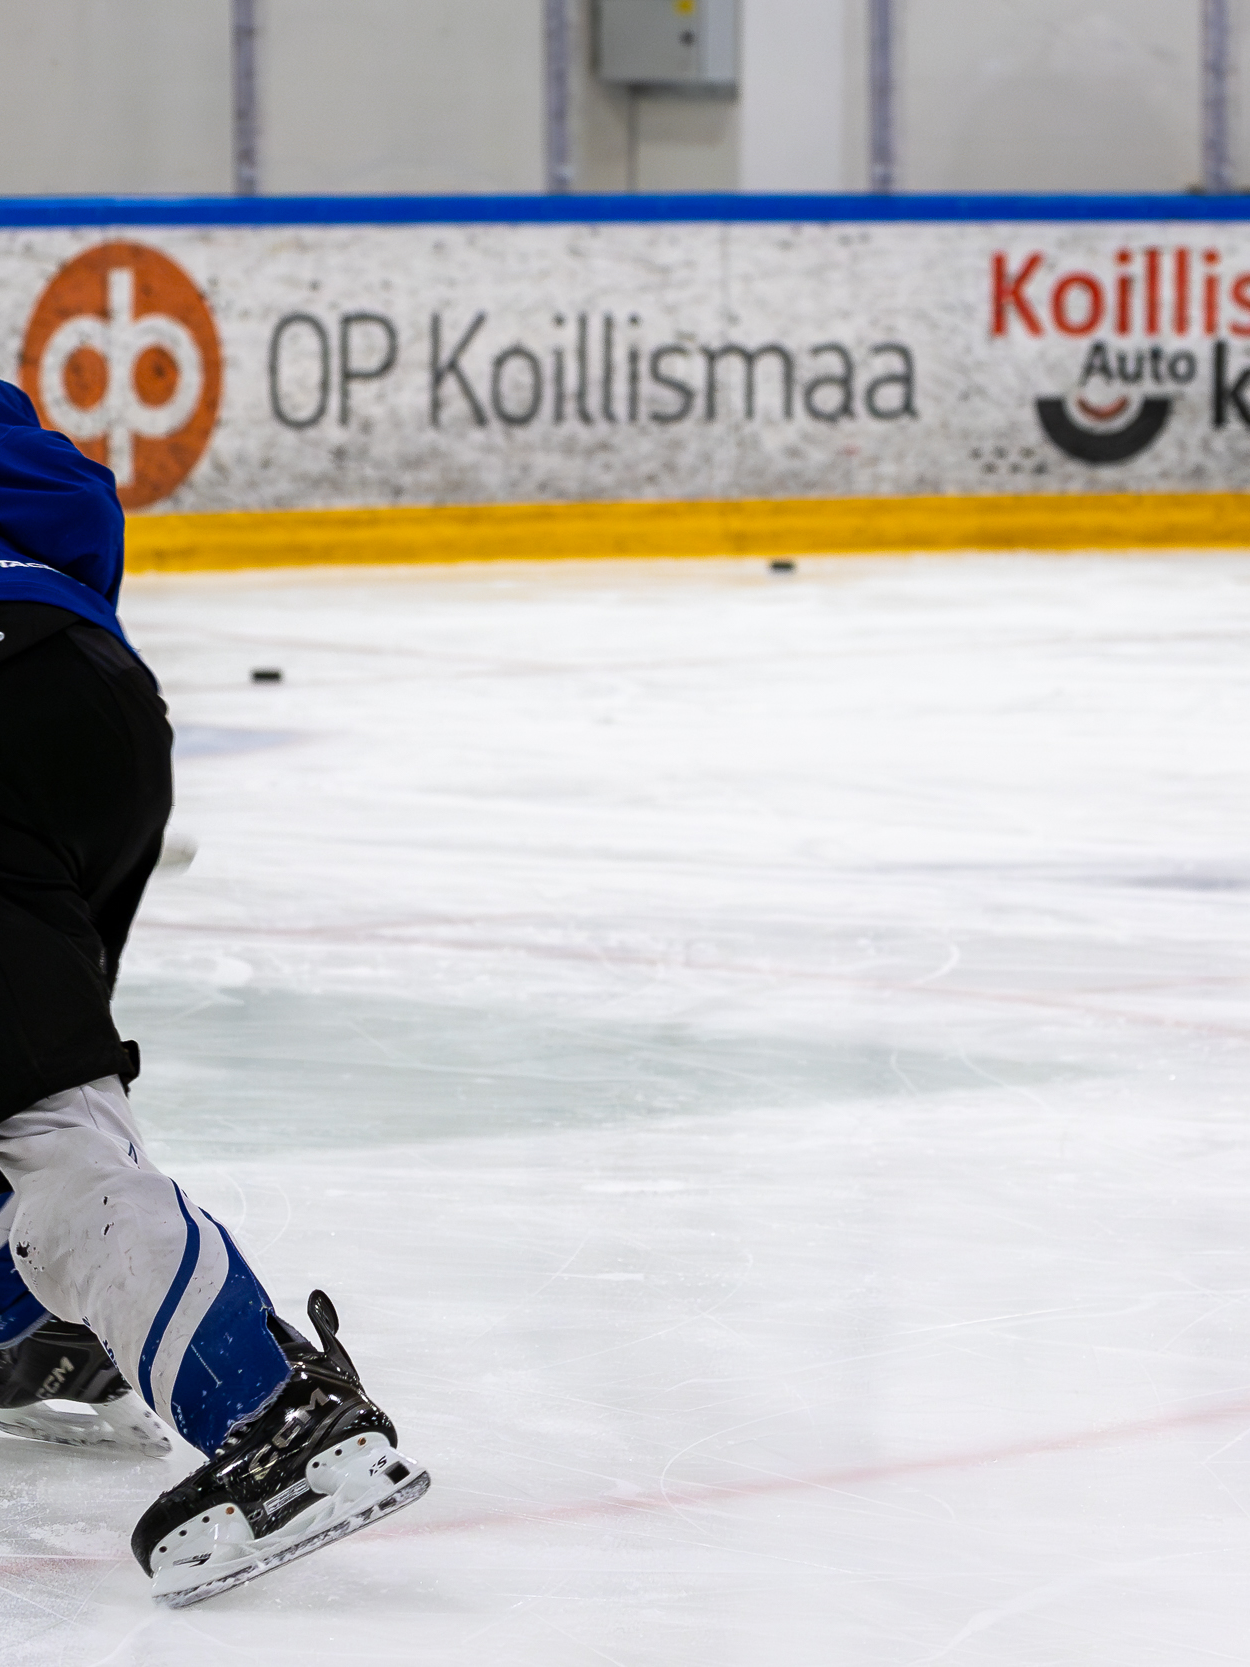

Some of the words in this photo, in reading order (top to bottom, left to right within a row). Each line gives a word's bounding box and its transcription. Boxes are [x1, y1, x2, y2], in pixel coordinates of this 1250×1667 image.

[269, 312, 399, 429] OP
[429, 311, 919, 427] Koillismaa
[1078, 340, 1197, 387] Auto
[35, 1356, 75, 1400] CCM
[249, 1387, 330, 1480] CCM
